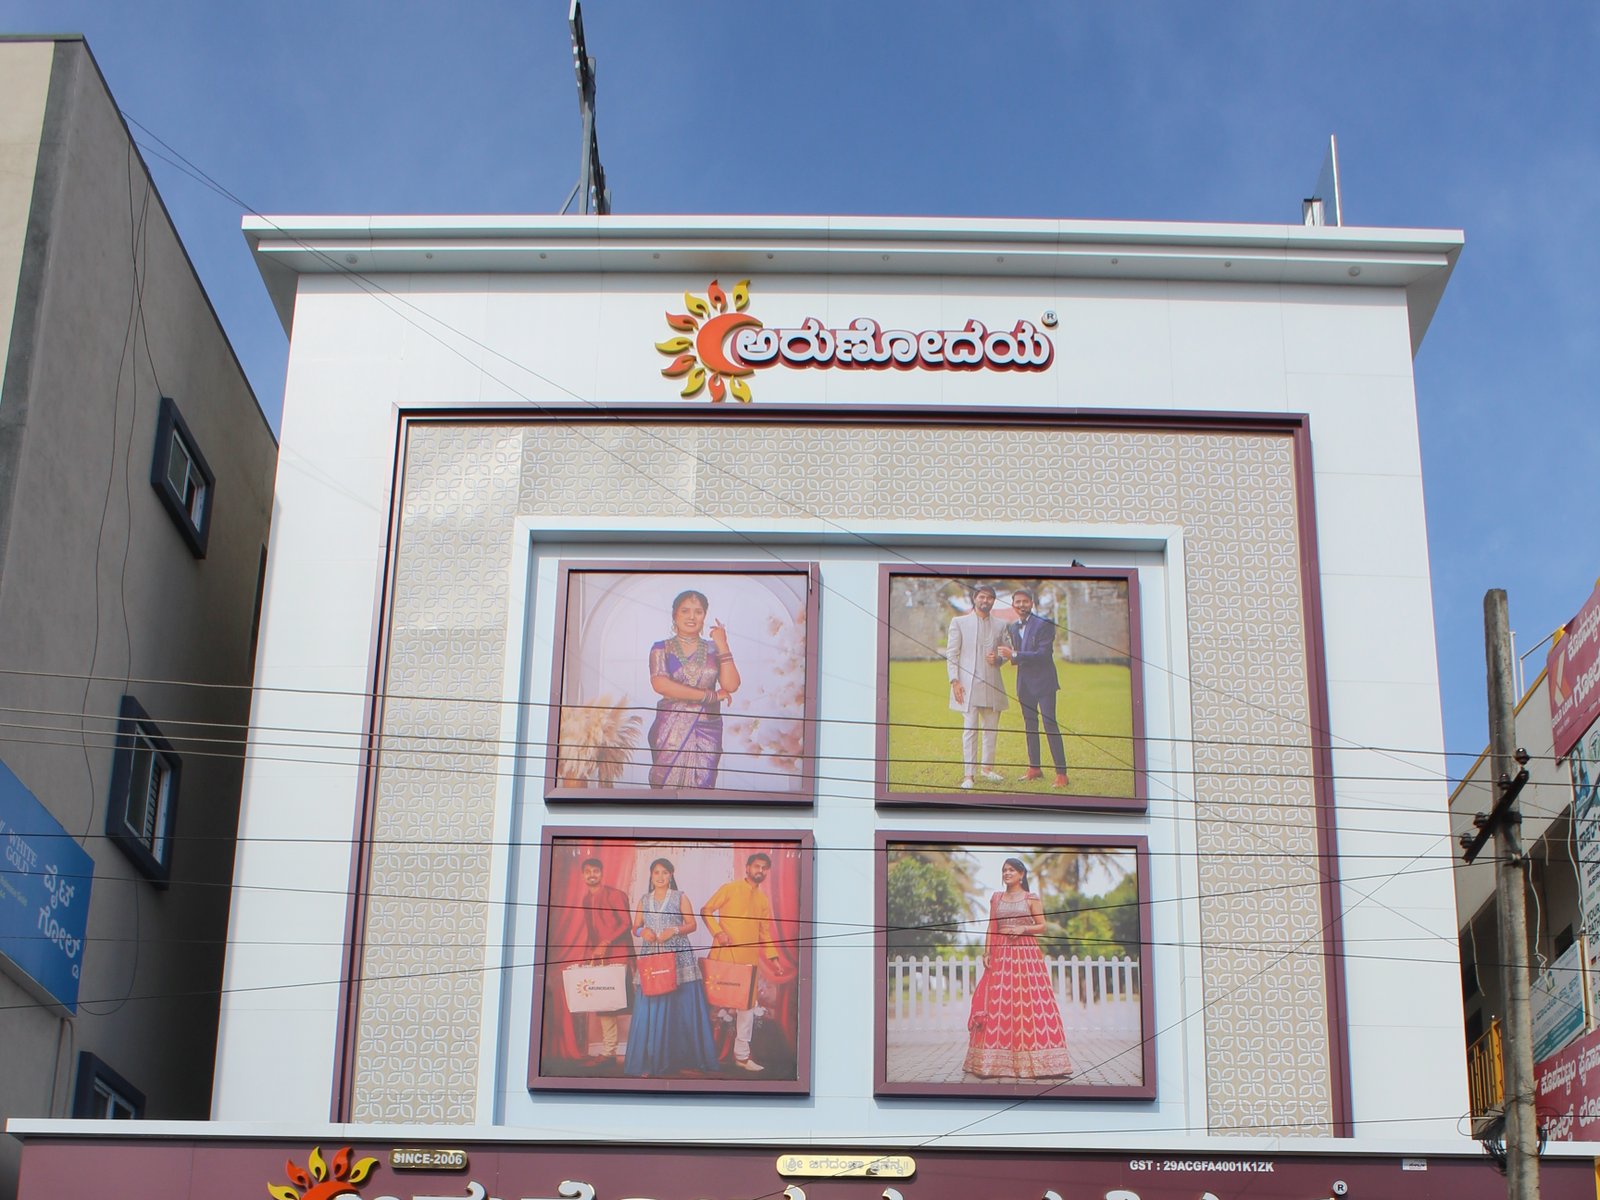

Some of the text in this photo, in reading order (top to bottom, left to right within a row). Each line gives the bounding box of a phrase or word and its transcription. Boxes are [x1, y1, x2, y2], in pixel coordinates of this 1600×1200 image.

[735, 317, 1052, 367] ಅರುಣೋದಯ
[6, 846, 29, 876] GOLD
[9, 828, 38, 868] WHITE
[393, 1152, 463, 1166] SINCE-2006
[1129, 1160, 1153, 1171] GST
